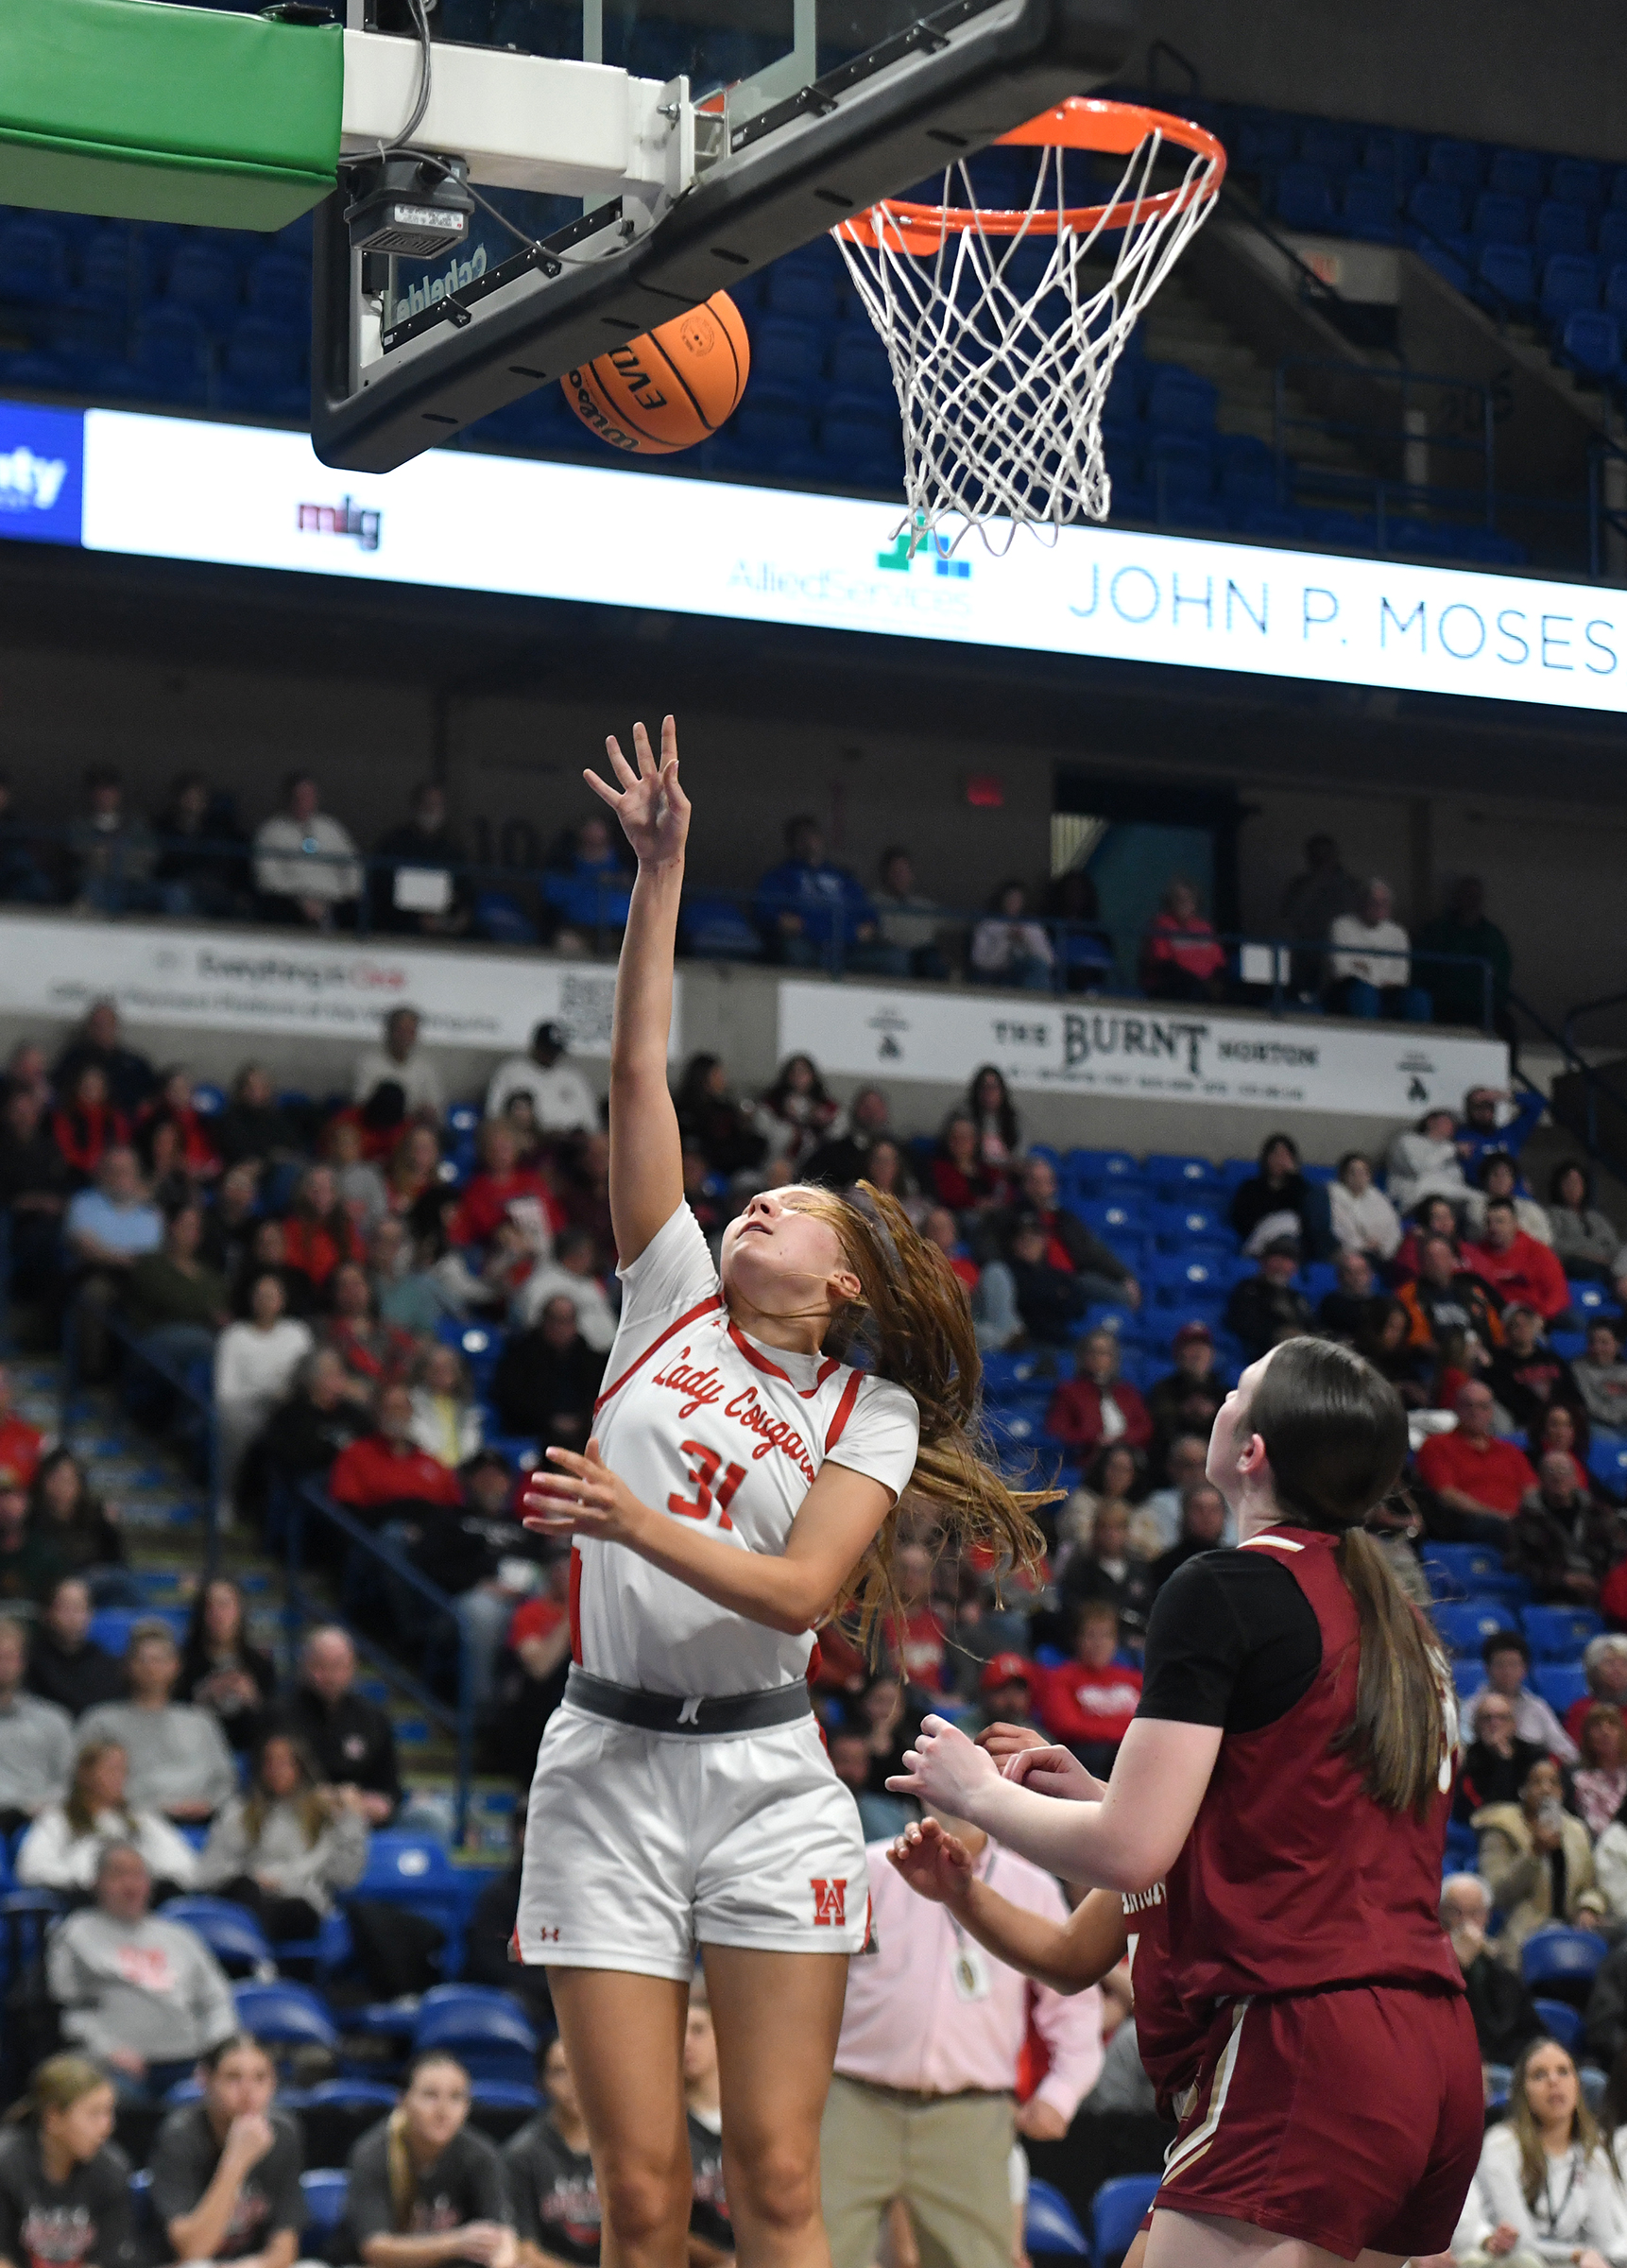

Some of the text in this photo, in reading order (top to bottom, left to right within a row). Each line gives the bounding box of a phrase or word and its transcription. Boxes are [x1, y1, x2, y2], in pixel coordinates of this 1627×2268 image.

[569, 369, 641, 452] Wilso
[1069, 563, 1617, 675] JOHN P. MOSES
[995, 1020, 1049, 1046] THE
[1062, 1012, 1208, 1075] BURNT
[652, 1346, 725, 1419] Lady
[667, 1439, 747, 1531] 31
